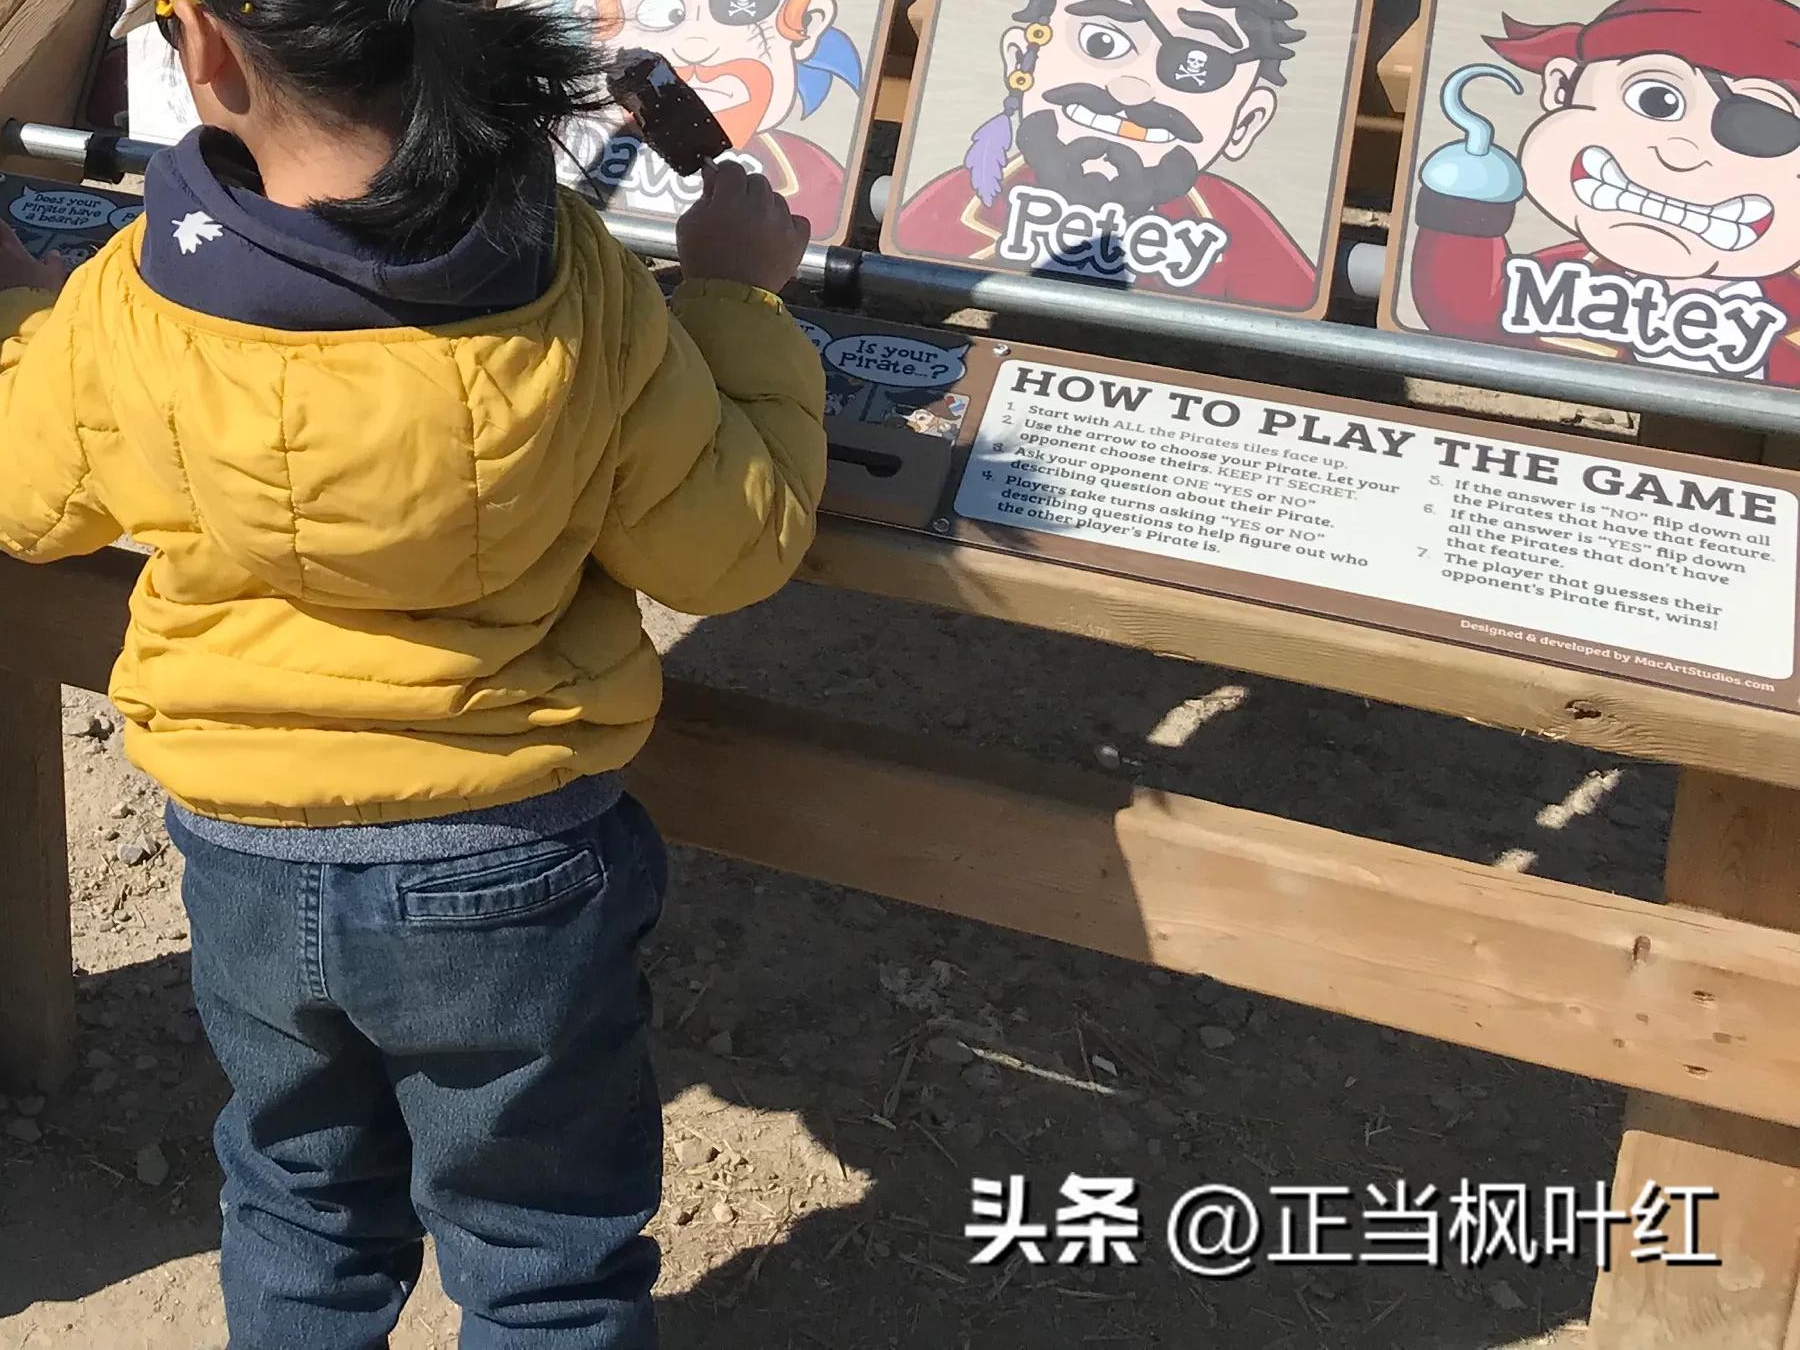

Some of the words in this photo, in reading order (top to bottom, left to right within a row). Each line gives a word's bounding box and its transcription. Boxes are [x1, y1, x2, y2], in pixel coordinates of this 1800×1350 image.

[21, 201, 66, 215] Pirate
[68, 206, 103, 218] have
[25, 212, 36, 221] a
[38, 211, 89, 226] beard?
[34, 193, 65, 205] Does
[66, 196, 102, 209] your
[1007, 192, 1226, 279] Petey
[1511, 267, 1777, 364] Matey
[856, 339, 875, 354] Is
[881, 346, 939, 364] your
[1010, 366, 1153, 412] HOW
[1168, 391, 1241, 427] TO
[1257, 407, 1416, 458] PLAY
[1433, 436, 1560, 486] THE
[1582, 464, 1776, 525] GAME
[1019, 433, 1096, 453] opponent
[1099, 445, 1156, 463] choose
[1160, 456, 1212, 474] theirs.
[1217, 466, 1263, 482] KEEP
[1265, 474, 1284, 486] IT
[1286, 479, 1357, 500] SECRET.
[1024, 418, 1052, 432] Use
[1056, 424, 1082, 437] the
[1085, 431, 1137, 446] arrow
[1140, 439, 1157, 450] to
[1159, 443, 1217, 461] choose
[1219, 454, 1262, 468] your
[1264, 461, 1321, 480] Pirate.
[1326, 472, 1354, 486] Let
[1356, 479, 1400, 493] your
[1027, 405, 1069, 421] Start
[1072, 413, 1109, 427] with
[1112, 419, 1145, 433] ALL
[1149, 426, 1176, 438] the
[1179, 430, 1239, 449] Pirates
[1243, 442, 1278, 456] tiles
[1282, 448, 1318, 463] face
[1322, 457, 1348, 470] up.
[1005, 474, 1067, 496] Players
[1069, 488, 1106, 503] take
[1110, 495, 1156, 512] turns
[1159, 506, 1216, 525] asking
[1264, 525, 1285, 536] or
[1009, 459, 1097, 485] describing
[1099, 477, 1172, 498] question
[1175, 490, 1226, 508] about
[1230, 499, 1273, 516] their
[1276, 507, 1334, 528] Pirate.
[1014, 446, 1046, 461] Ask
[1045, 453, 1087, 467] your
[1089, 461, 1168, 483] opponent
[1172, 475, 1209, 490] ONE
[1256, 492, 1276, 502] or
[997, 501, 1024, 515] the
[1026, 509, 1073, 528] other
[1072, 517, 1142, 537] player's
[1145, 529, 1199, 549] Pirate
[1202, 539, 1220, 553] is.
[1000, 488, 1088, 515] describing
[1091, 507, 1173, 530] questions
[1177, 522, 1194, 533] to
[1197, 525, 1235, 543] help
[1238, 532, 1291, 552] figure
[1295, 546, 1326, 559] out
[1330, 552, 1368, 567] who
[1450, 508, 1466, 520] If
[1468, 512, 1498, 526] the
[1502, 520, 1573, 540] answer
[1577, 531, 1593, 544] is
[1656, 546, 1688, 564] flip
[1691, 554, 1746, 573] down
[1452, 493, 1482, 507] the
[1486, 498, 1553, 520] Pirates
[1558, 512, 1598, 529] that
[1602, 519, 1648, 538] have
[1653, 530, 1694, 547] that
[1698, 537, 1774, 562] feature.
[1454, 479, 1470, 491] If
[1472, 483, 1502, 497] the
[1506, 490, 1576, 510] answer
[1580, 501, 1596, 514] is
[1652, 515, 1684, 532] flip
[1687, 522, 1741, 541] down
[1745, 534, 1770, 547] all
[1443, 551, 1478, 568] The
[1481, 561, 1544, 580] player
[1548, 573, 1589, 590] that
[1593, 583, 1669, 605] guesses
[1673, 597, 1723, 616] their
[1446, 537, 1486, 553] that
[1490, 544, 1564, 568] feature.
[1448, 523, 1471, 536] all
[1475, 528, 1506, 542] the
[1510, 533, 1578, 555] Pirates
[1582, 548, 1624, 565] that
[1628, 556, 1678, 575] don't
[1682, 565, 1729, 585] have
[1441, 569, 1544, 596] opponent's
[1549, 587, 1609, 609] Pirate
[1614, 600, 1660, 621] first,
[1665, 612, 1718, 631] wins!
[1460, 619, 1524, 640] Designed
[1525, 633, 1537, 643] &
[1539, 636, 1611, 658] developed
[1613, 650, 1631, 663] by
[1633, 655, 1775, 692] MacArtStudios.com
